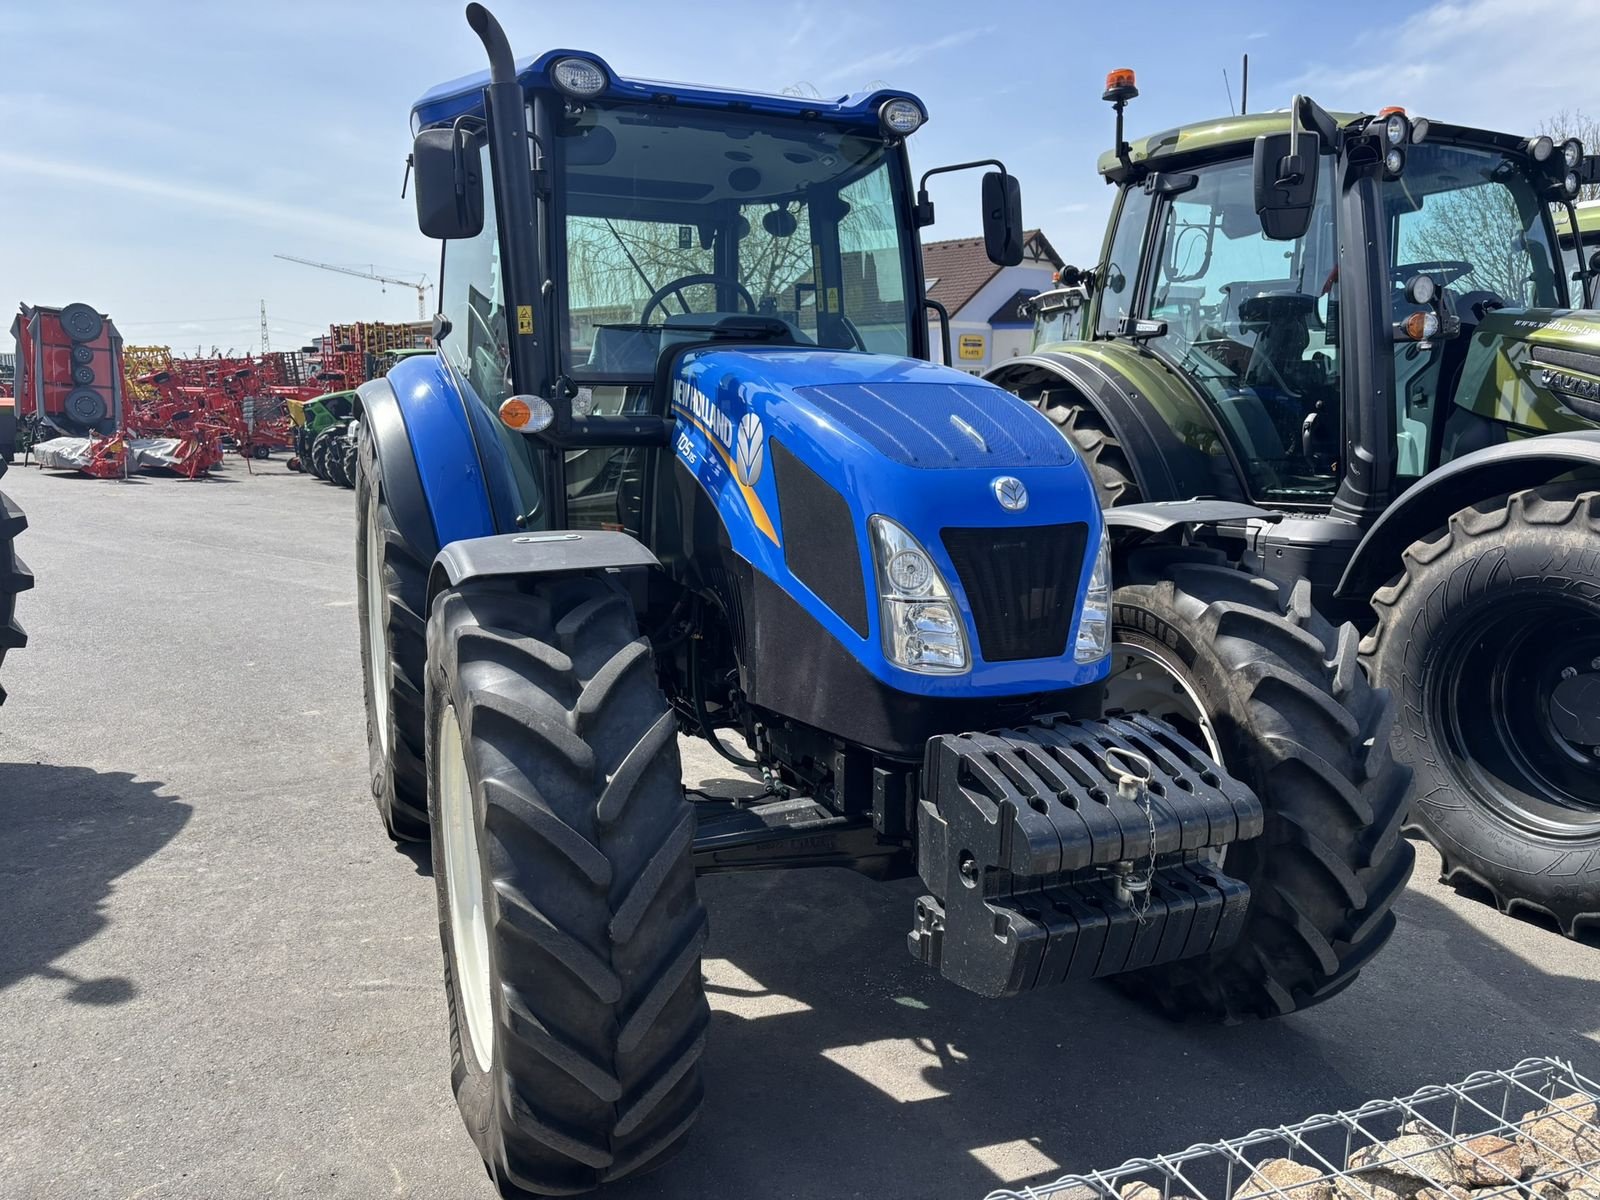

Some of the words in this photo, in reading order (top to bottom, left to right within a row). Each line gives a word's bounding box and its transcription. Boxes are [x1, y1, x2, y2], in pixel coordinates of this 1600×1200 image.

[1541, 369, 1600, 398] VALTRA
[673, 379, 690, 407] NEW
[690, 387, 732, 448] HOLLAND
